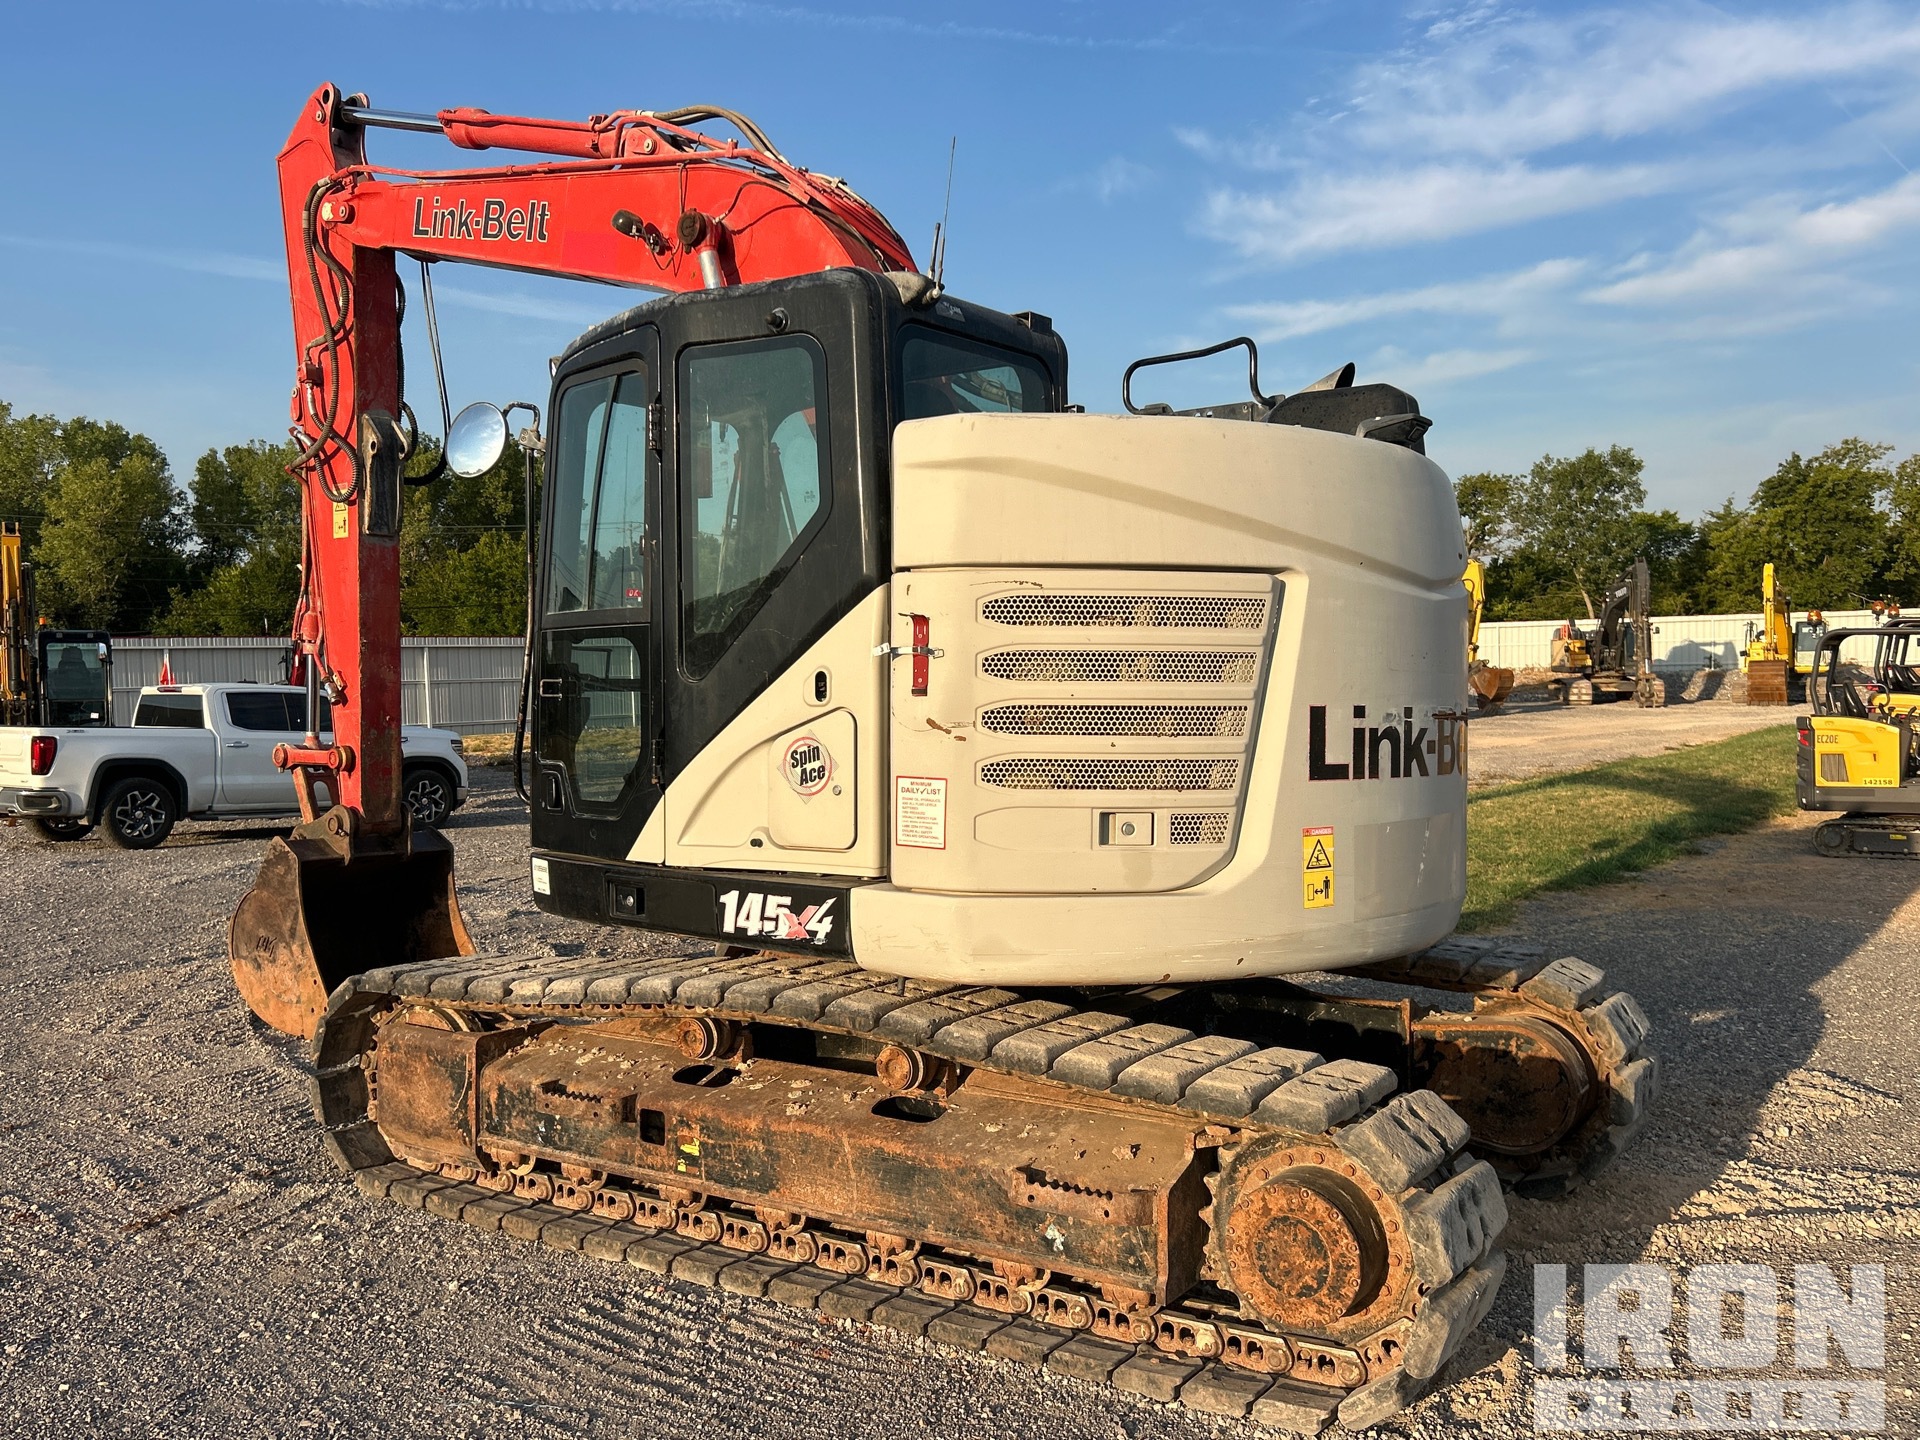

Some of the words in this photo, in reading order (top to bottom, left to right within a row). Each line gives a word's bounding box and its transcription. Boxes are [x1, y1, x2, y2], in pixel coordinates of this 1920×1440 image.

[413, 197, 550, 242] Link-Belt
[1817, 735, 1839, 744] EC20E
[790, 745, 821, 768] Spin
[800, 765, 826, 786] Ace
